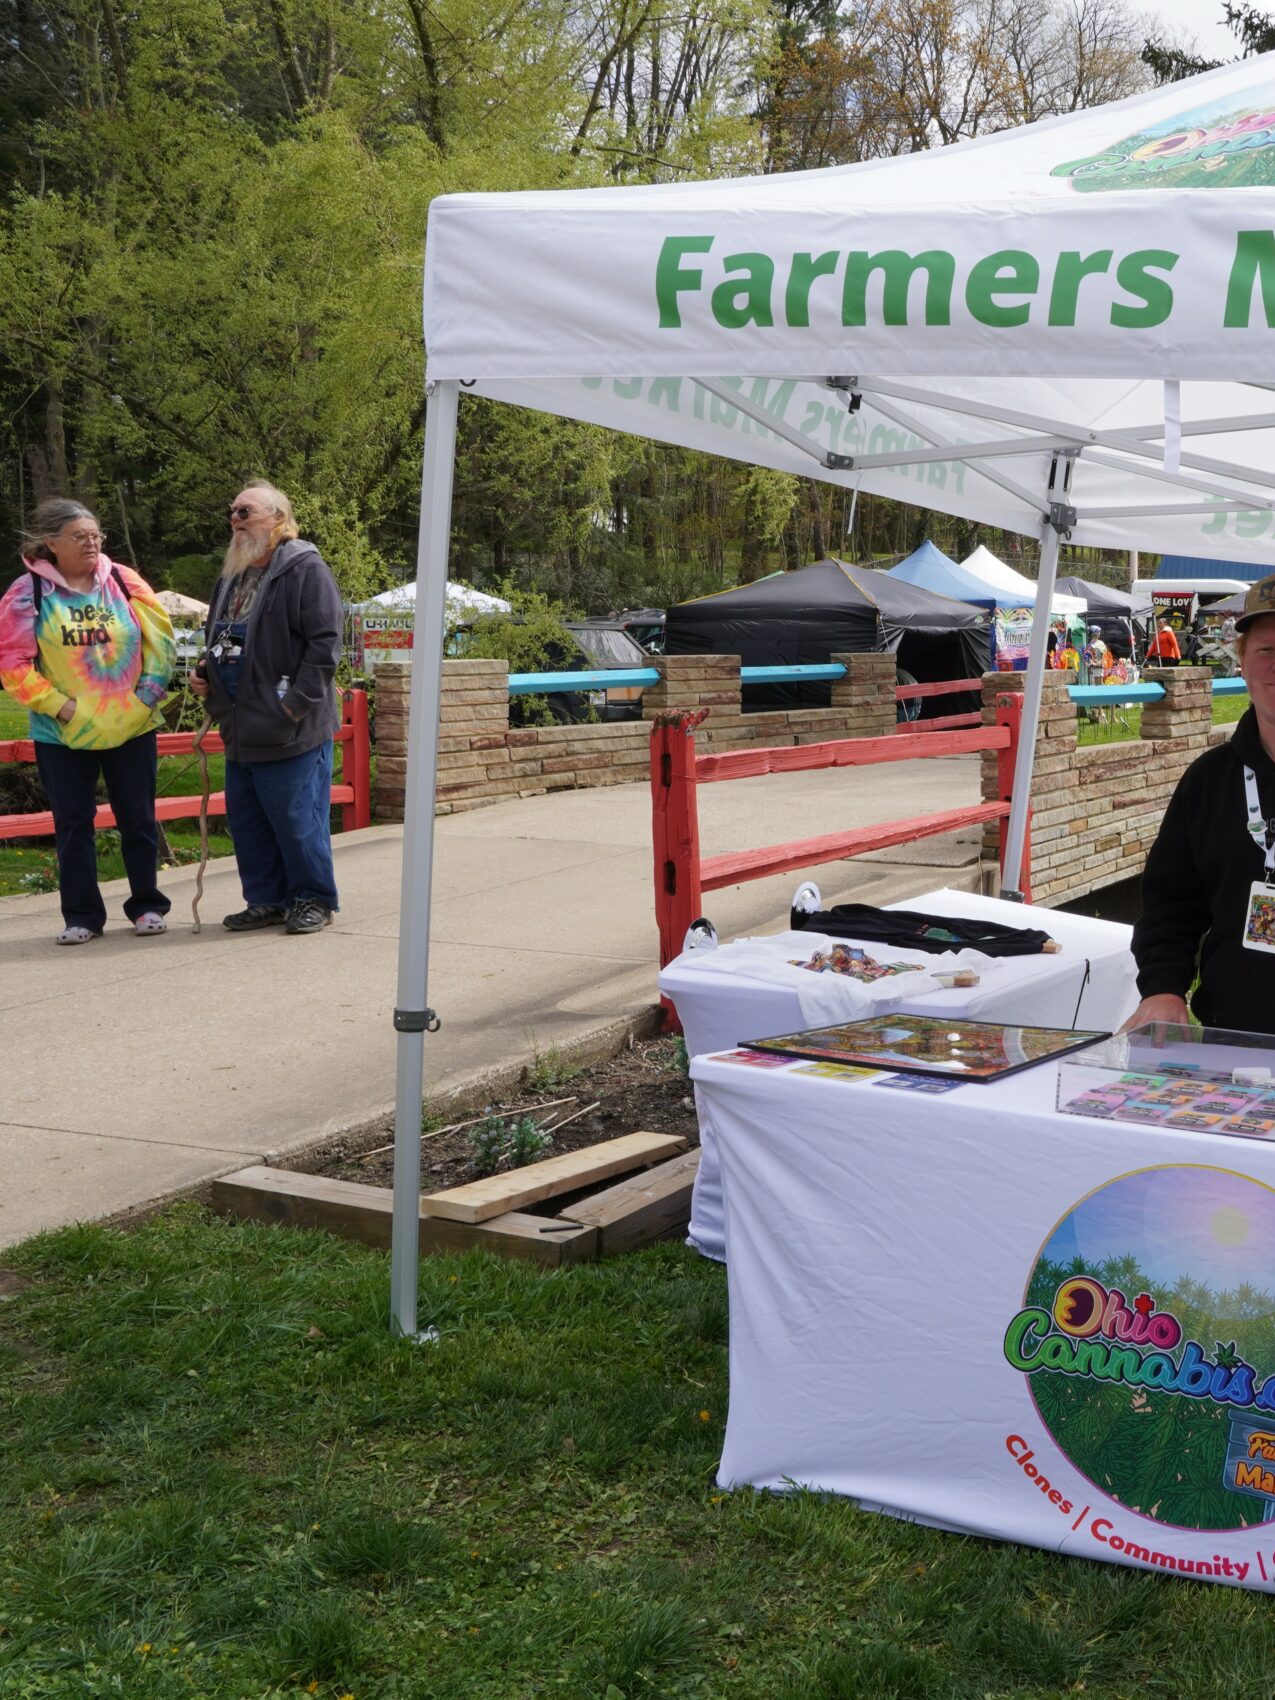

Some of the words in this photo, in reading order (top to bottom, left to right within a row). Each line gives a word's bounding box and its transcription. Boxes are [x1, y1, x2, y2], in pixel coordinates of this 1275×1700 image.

[656, 235, 1180, 329] Farmers
[67, 604, 97, 623] be
[1153, 597, 1172, 606] ONE
[60, 623, 112, 647] kind
[1053, 1276, 1182, 1349] Ohio
[1005, 1434, 1074, 1515] Clones
[1090, 1518, 1251, 1581] Community
